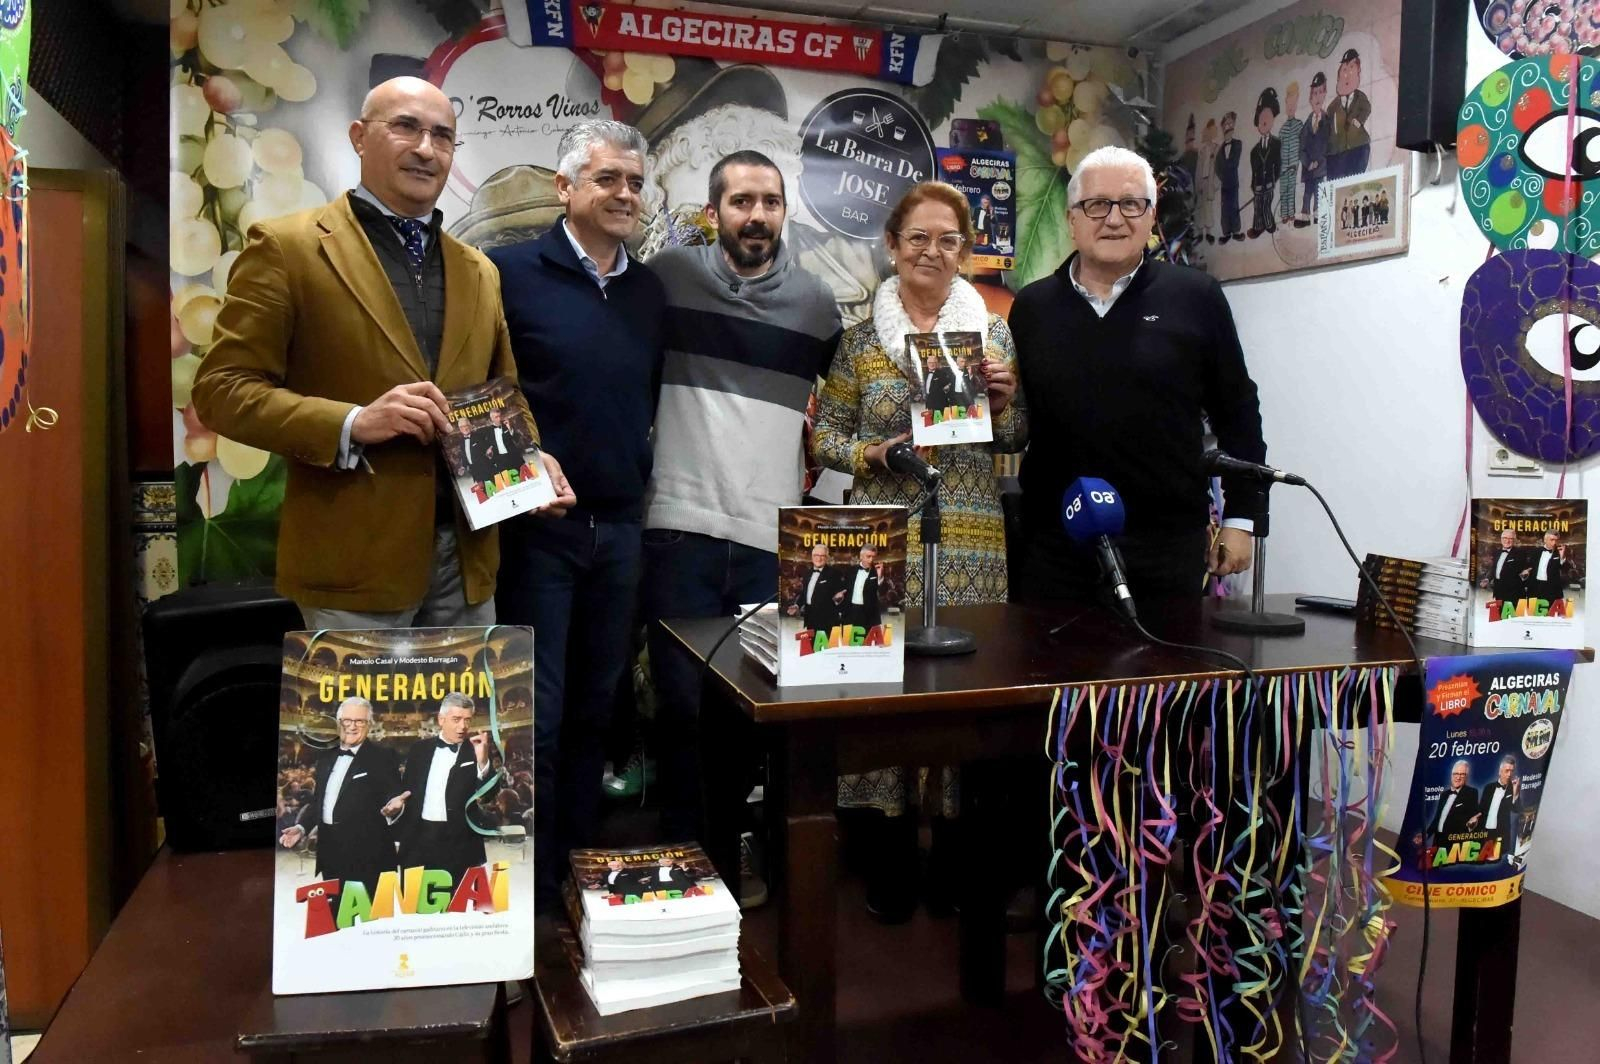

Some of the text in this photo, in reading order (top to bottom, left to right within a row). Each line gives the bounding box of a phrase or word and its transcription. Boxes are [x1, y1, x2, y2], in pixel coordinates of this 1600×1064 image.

[617, 12, 844, 59] ALGECIRAS CF
[546, 93, 600, 120] Vinos
[815, 128, 924, 183] La Barra De
[971, 158, 1010, 168] ALGECIRAS
[833, 171, 891, 205] JOSE
[841, 206, 869, 225] BAR
[449, 397, 505, 423] GENERACIÓN
[1493, 518, 1569, 533] GENERACIÓN
[803, 531, 888, 548] GENERACIÓN
[375, 657, 393, 665] Casal
[399, 656, 428, 664] Modesto
[428, 656, 458, 665] Barragán
[319, 666, 494, 703] GENERACIÓN
[1490, 672, 1560, 691] ALGECIRAS
[1440, 697, 1467, 711] LIBRO
[1484, 688, 1561, 720] CARNAVAL
[1446, 729, 1468, 739] Lunes
[1428, 739, 1500, 759] 20 febrero
[596, 850, 685, 865] GENERACIÓN
